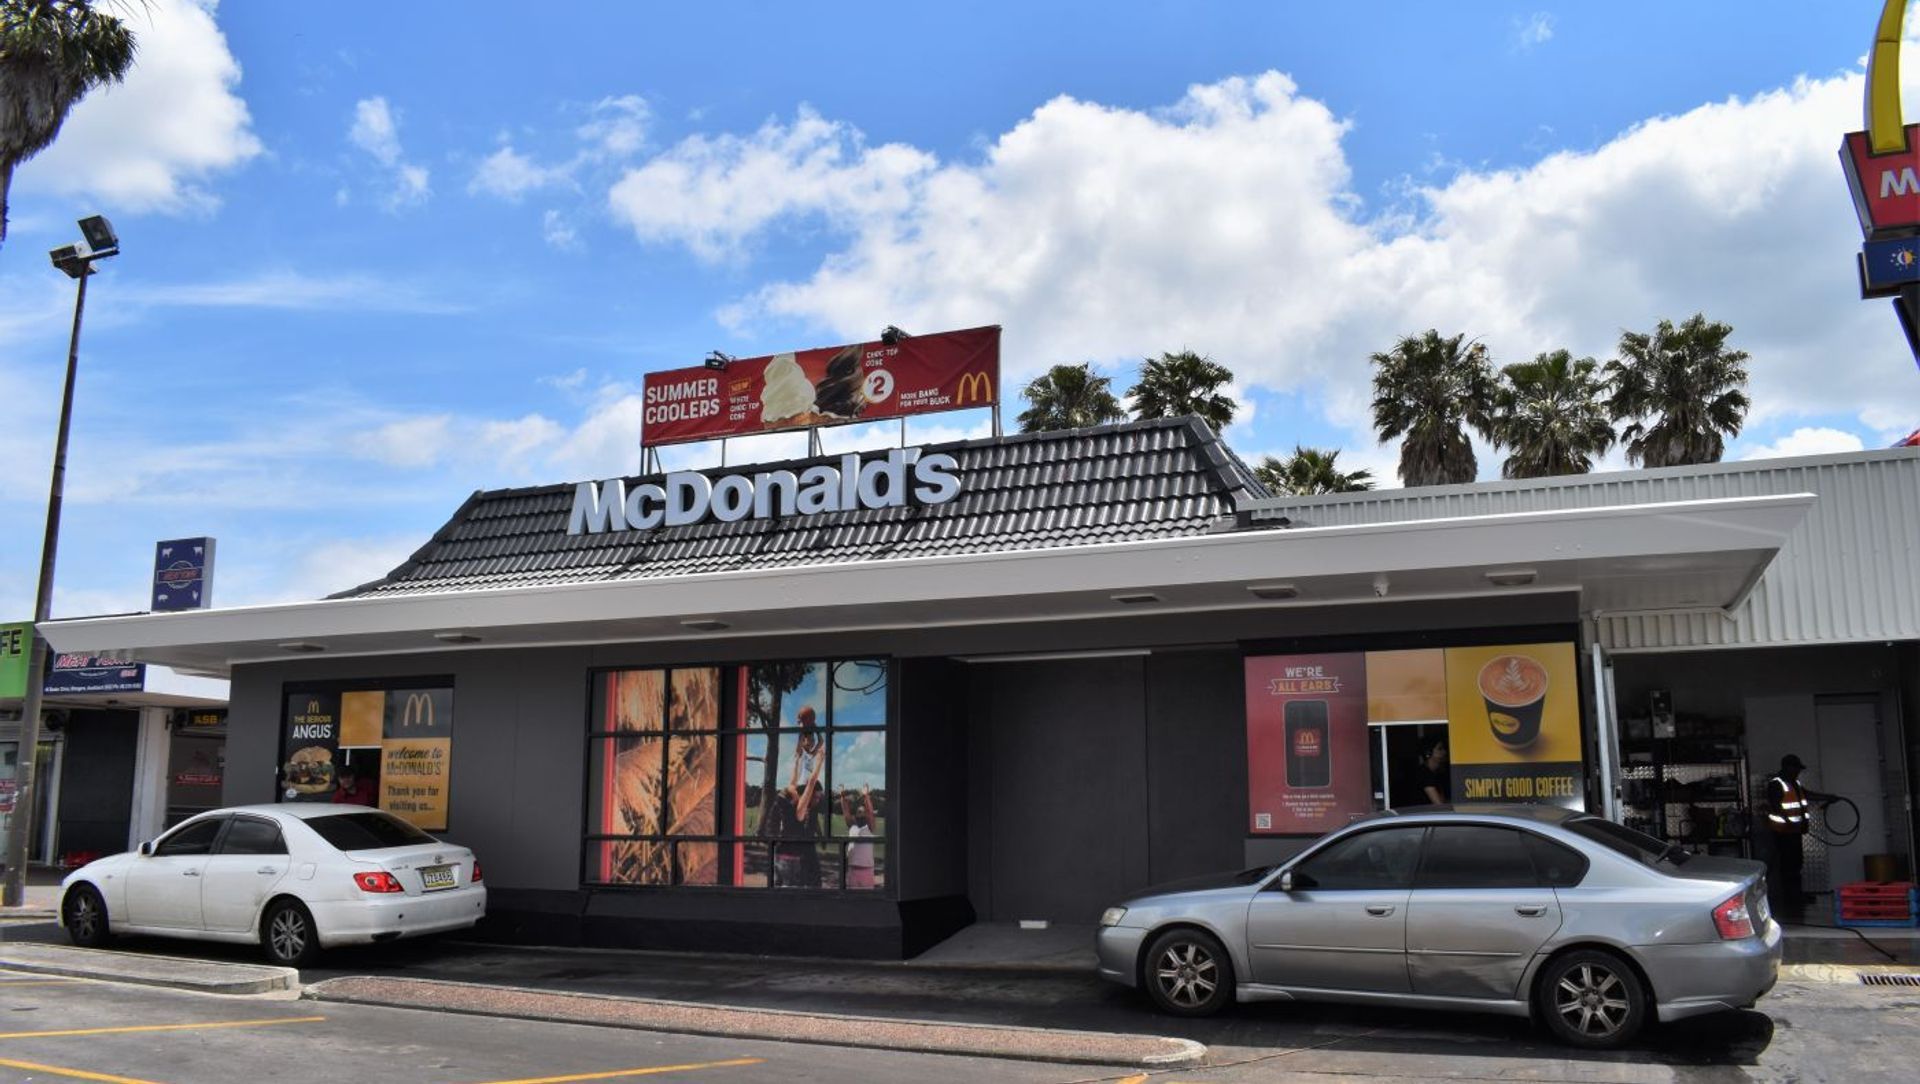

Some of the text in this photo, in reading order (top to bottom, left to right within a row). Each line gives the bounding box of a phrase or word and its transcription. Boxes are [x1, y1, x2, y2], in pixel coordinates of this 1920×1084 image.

[647, 378, 718, 404] SUMMER
[918, 388, 939, 399] BANG
[930, 395, 951, 406] BUCK
[646, 399, 720, 424] COOLERS
[566, 446, 961, 536] McDonald's
[1284, 665, 1324, 678] WE'RE
[387, 746, 443, 759] welcome to
[387, 784, 440, 799] Thank you for
[1465, 775, 1575, 798] SIMPLY GOOD COFFEE
